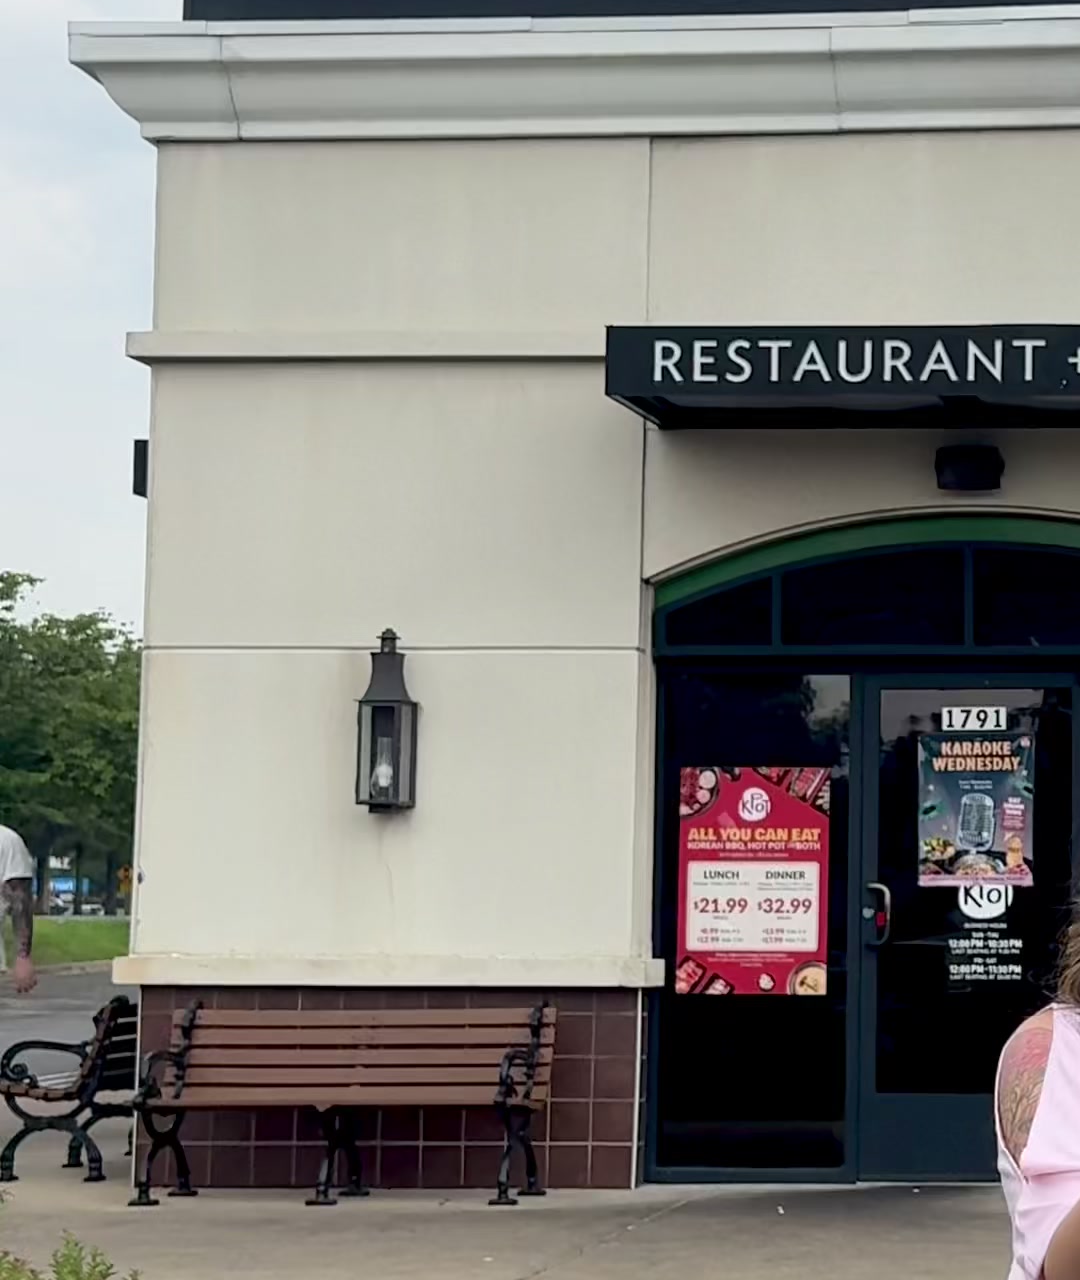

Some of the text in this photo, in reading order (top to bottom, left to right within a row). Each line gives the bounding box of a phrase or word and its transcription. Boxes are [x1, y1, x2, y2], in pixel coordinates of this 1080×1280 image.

[652, 337, 1046, 384] RESTAURANT
[946, 708, 1003, 728] 1791
[941, 741, 1012, 756] KARAOKE
[932, 756, 1021, 772] WEDNESDAY
[687, 827, 821, 842] ALL YOU CAN EAT
[747, 841, 767, 850] HOT
[768, 841, 786, 850] POT
[703, 870, 740, 880] LUNCH
[765, 870, 806, 880] DINNER
[693, 898, 749, 914] $21.99
[758, 898, 813, 914] $32.99
